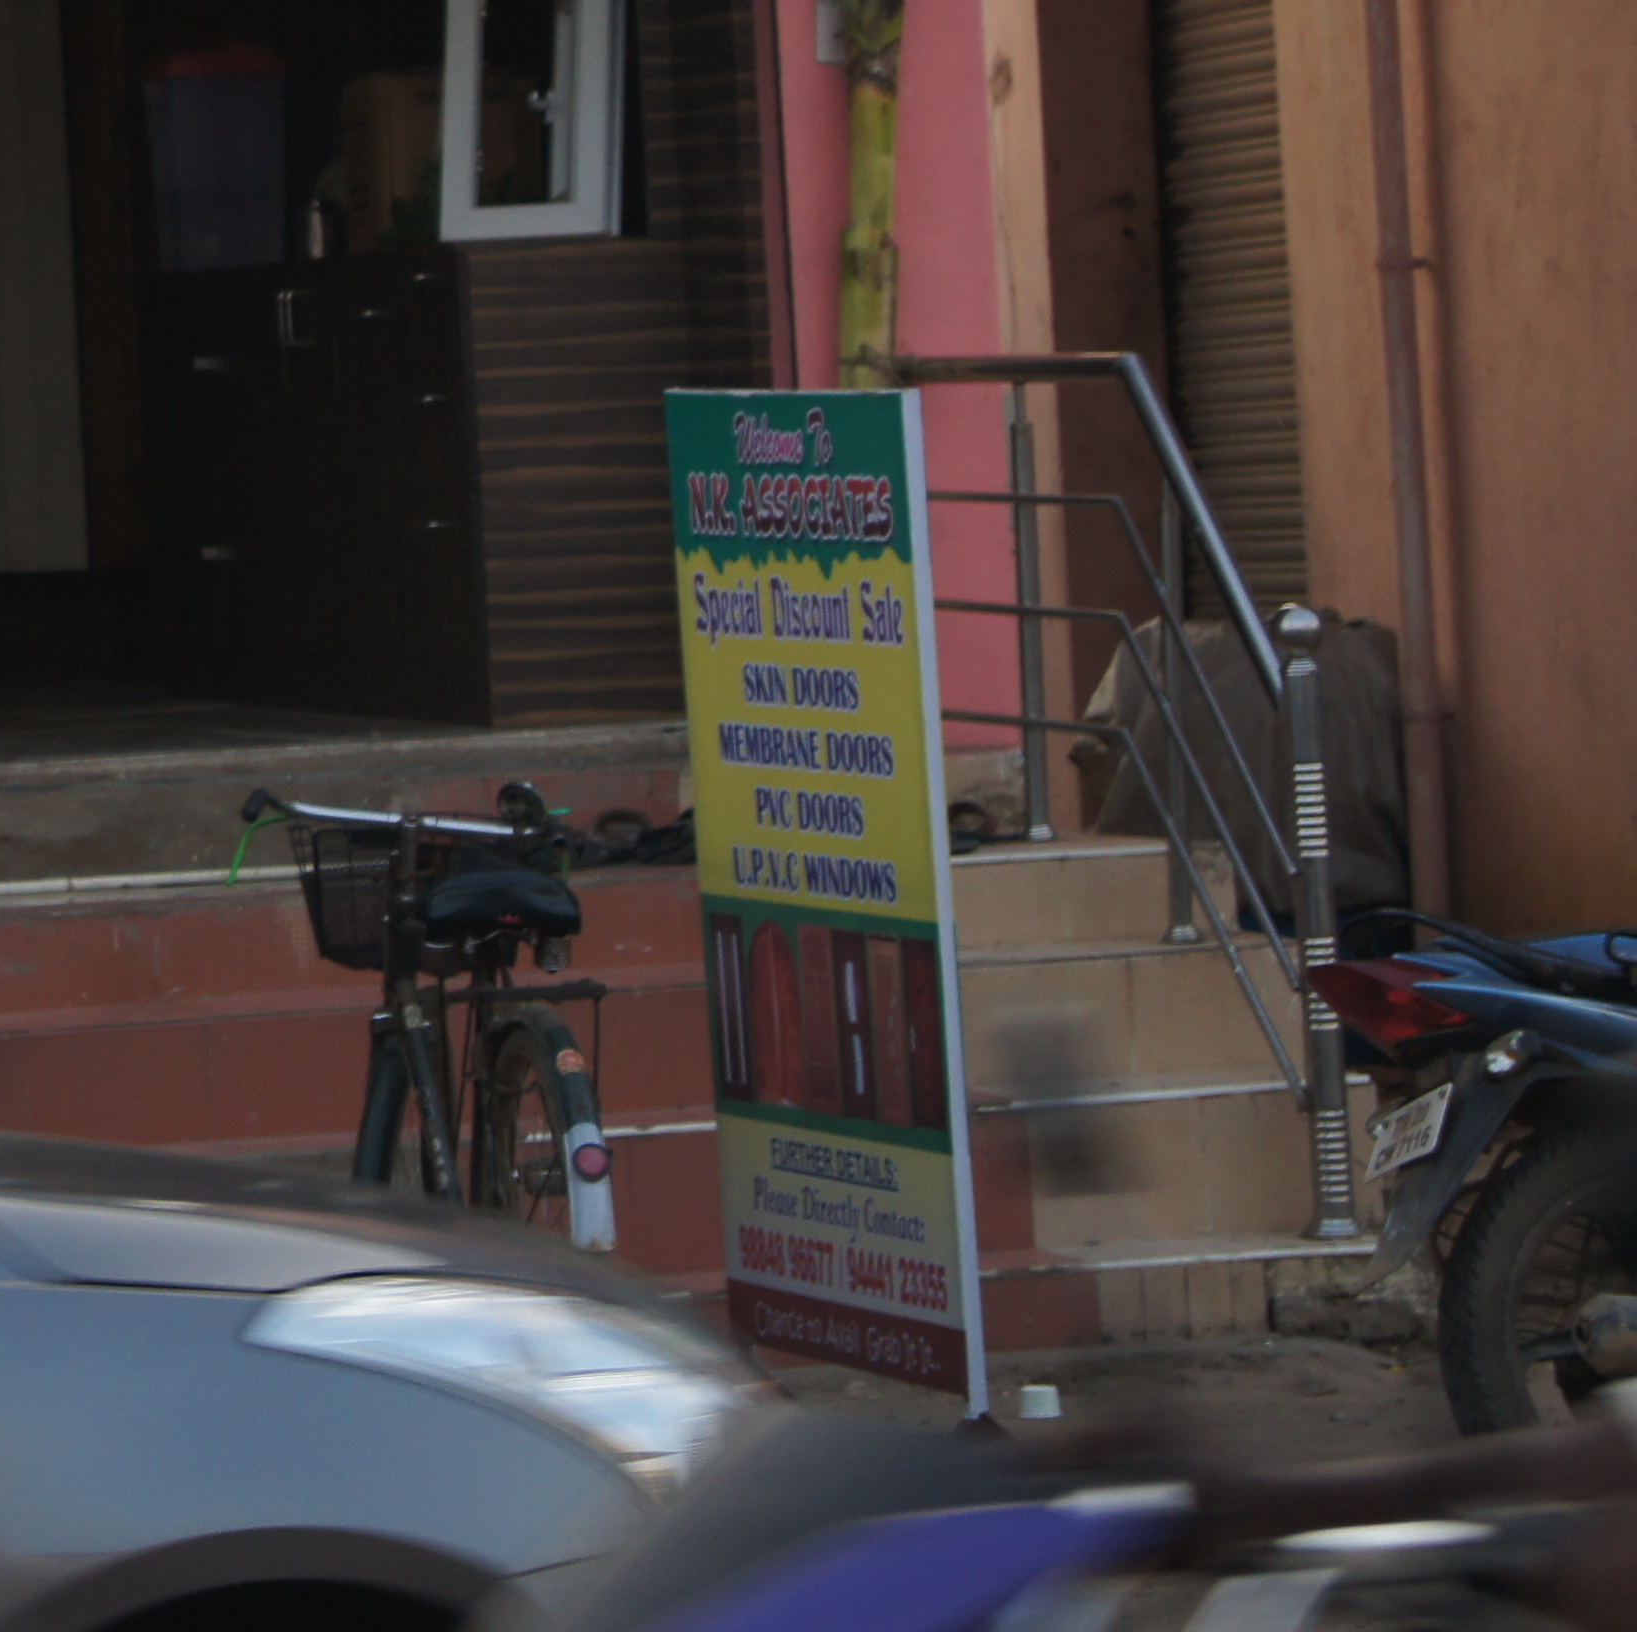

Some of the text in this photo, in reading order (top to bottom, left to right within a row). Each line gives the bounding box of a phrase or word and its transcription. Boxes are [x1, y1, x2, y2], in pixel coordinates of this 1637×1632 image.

[734, 407, 833, 467] Welcome To
[688, 470, 894, 542] N.K. ASSOCIATES
[694, 571, 905, 649] Special Discount Sale
[743, 662, 860, 714] SKIN DOORS
[719, 722, 895, 779] MEMBRANE DOORS
[755, 786, 864, 839] PVC DOORS
[804, 852, 899, 906] WINDOWS
[770, 1137, 835, 1176] FURTHER
[753, 1175, 798, 1219] Please
[802, 1186, 861, 1244] Directly
